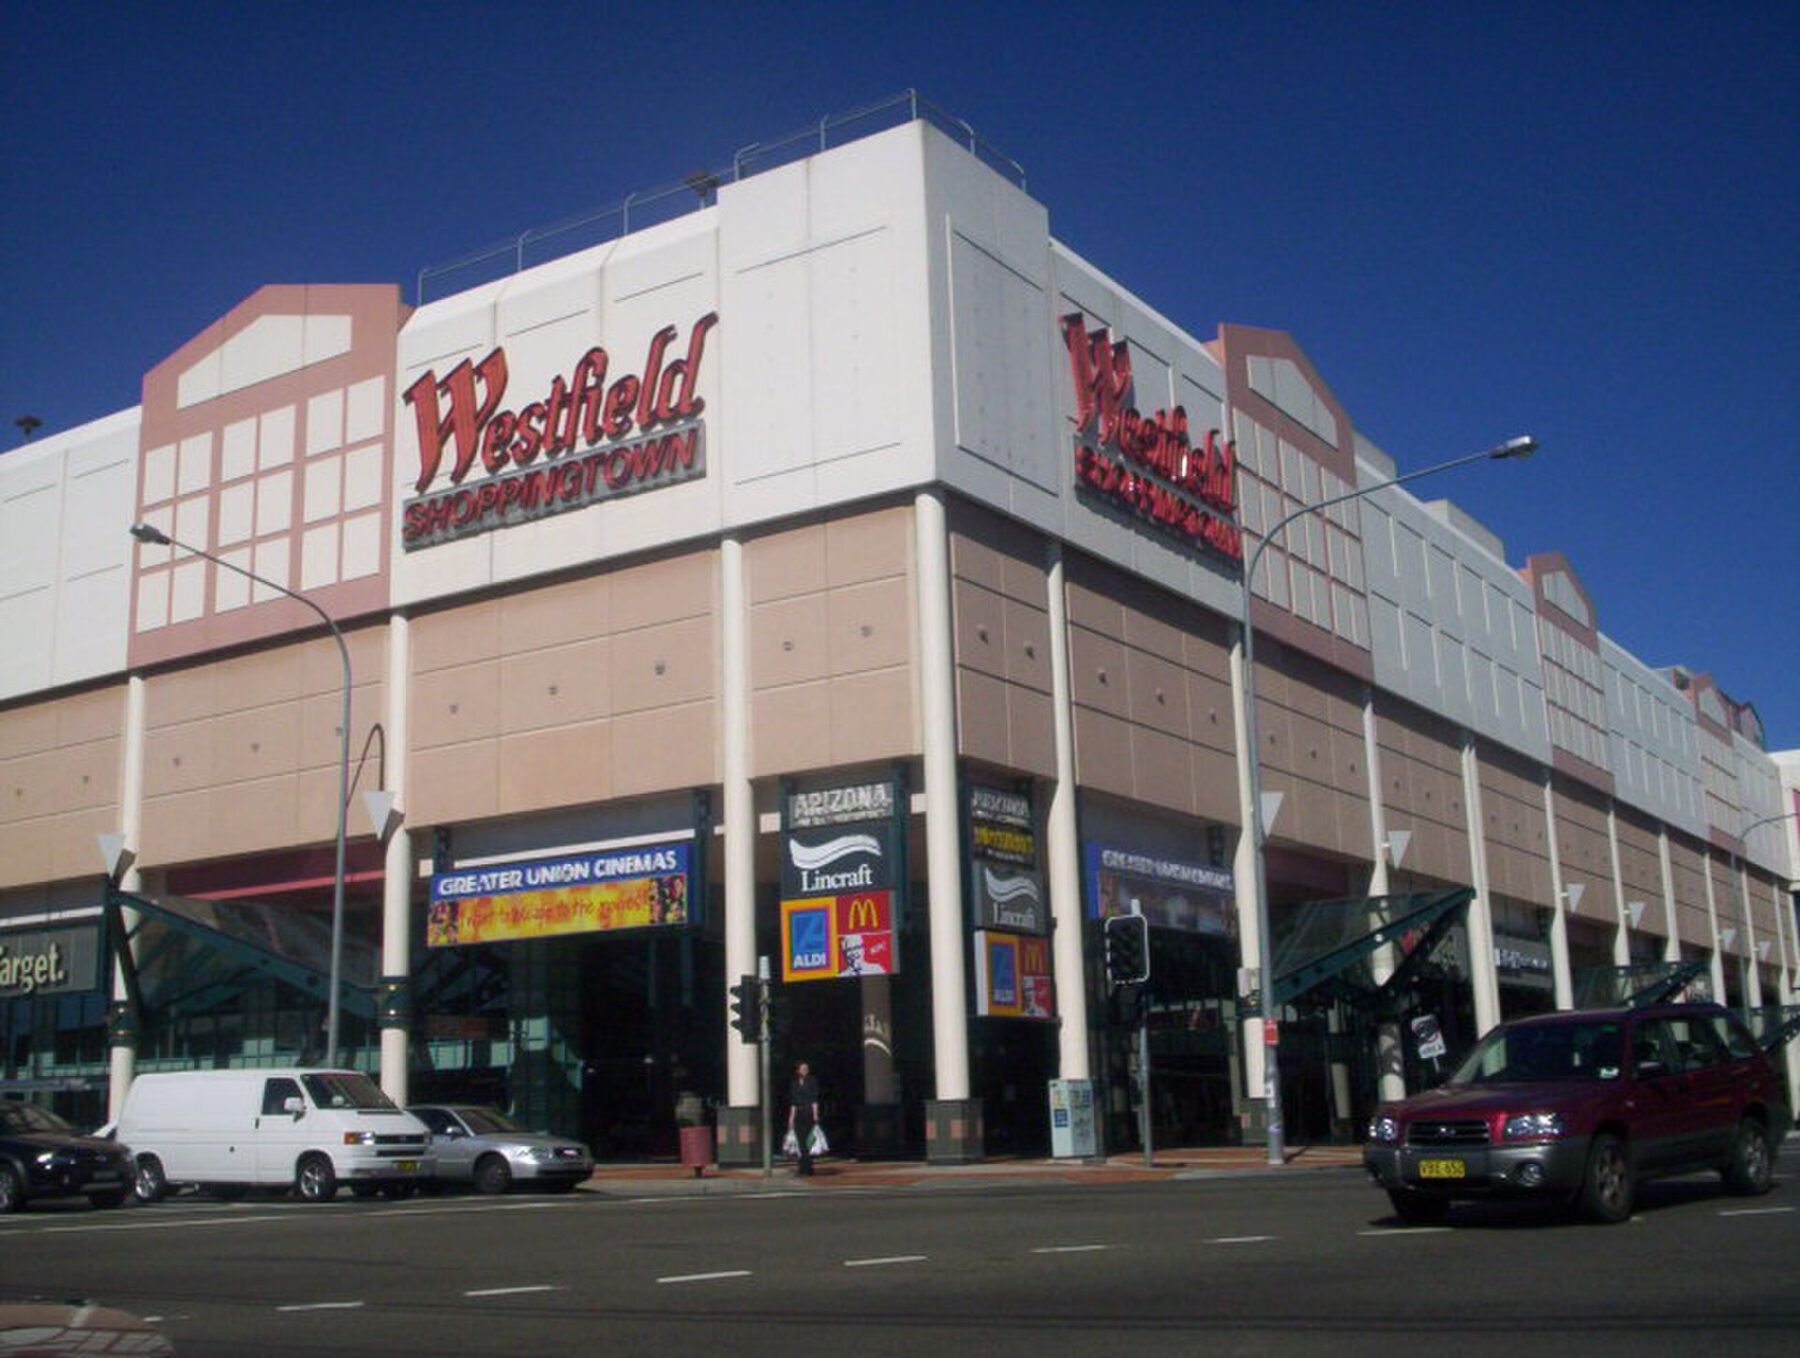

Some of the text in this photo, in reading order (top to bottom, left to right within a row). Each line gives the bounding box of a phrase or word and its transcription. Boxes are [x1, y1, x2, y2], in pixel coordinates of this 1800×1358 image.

[402, 311, 719, 493] Westfield
[402, 428, 699, 541] SHOPPINGTOWN
[794, 783, 887, 819] ARIZONA
[438, 849, 678, 896] GREATER UNION CINEMAS
[801, 863, 873, 892] Lincraft
[0, 942, 64, 993] arget.
[793, 953, 827, 969] ALDI
